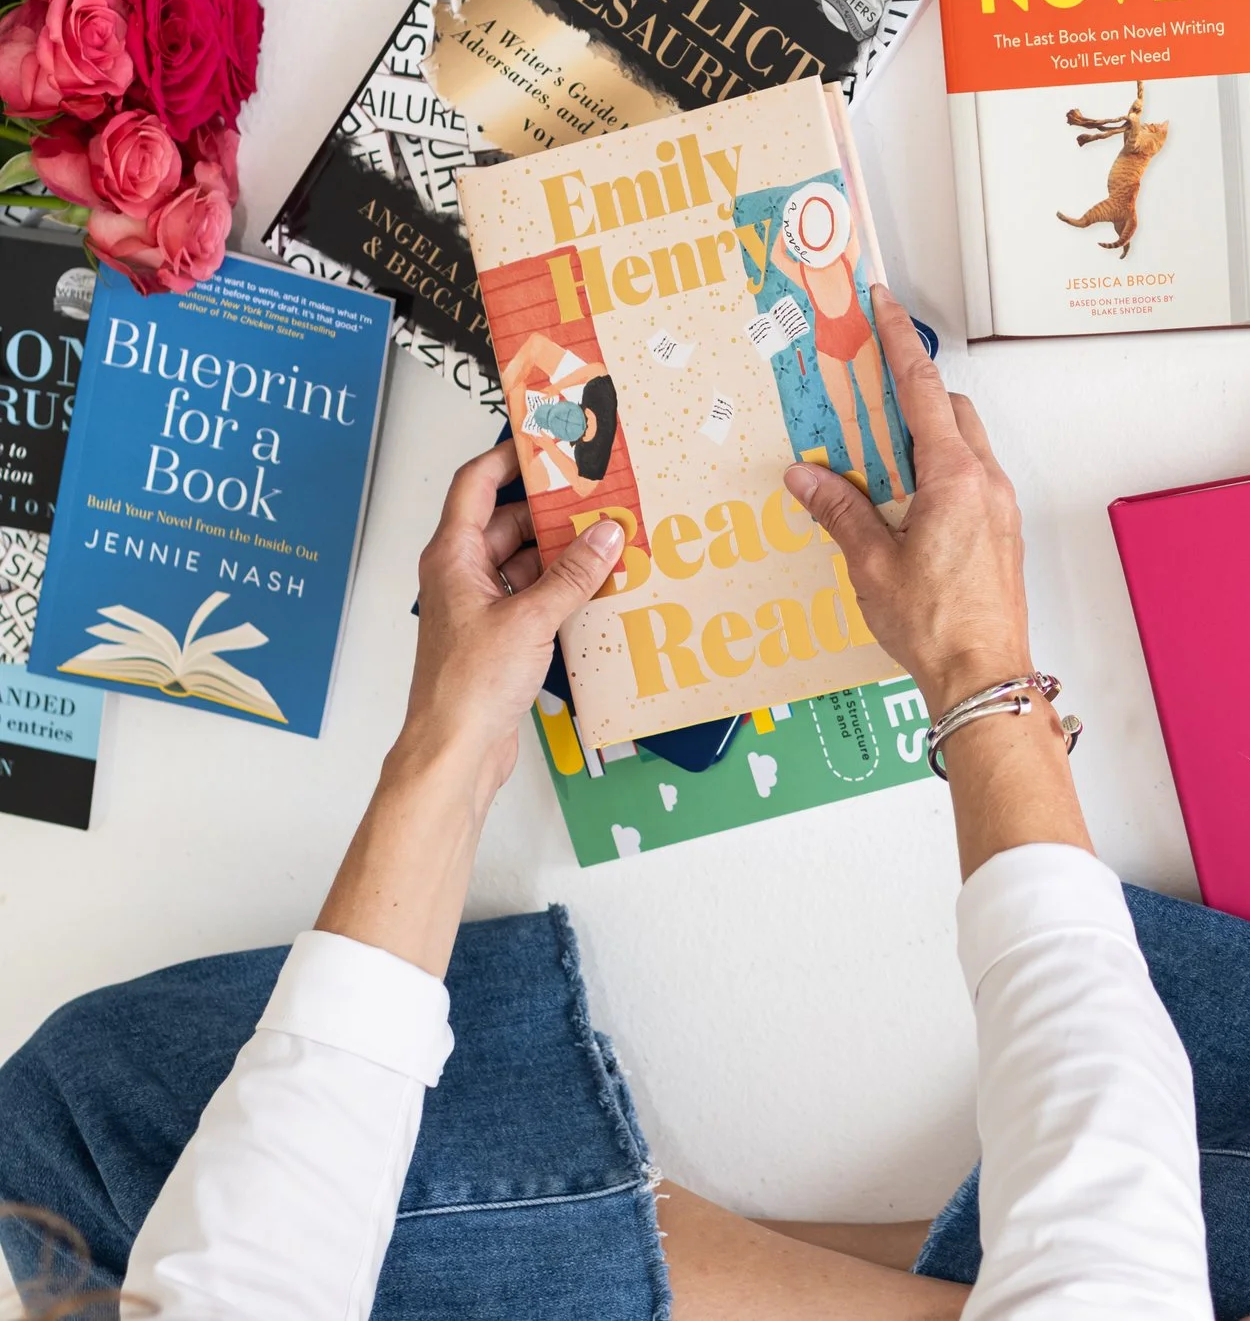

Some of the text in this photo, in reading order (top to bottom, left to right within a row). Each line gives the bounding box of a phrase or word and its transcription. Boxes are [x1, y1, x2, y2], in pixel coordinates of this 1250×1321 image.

[993, 19, 1225, 49] The Last Book on Novel Writing
[1050, 47, 1171, 70] You'll Ever Need
[450, 29, 595, 136] Adversaries, and
[476, 19, 618, 127] A Writer's Guide
[538, 134, 743, 245] Emily
[358, 198, 458, 284] ANGELA
[545, 212, 772, 326] Henry
[782, 201, 812, 265] a novel
[362, 236, 462, 322] & BECCA
[1065, 272, 1176, 290] JESSICA BRODY
[1091, 305, 1153, 316] BLAKE SNYDER
[103, 317, 357, 425] Blueprint
[161, 387, 280, 465] for a
[143, 444, 281, 521] Book
[84, 529, 305, 598] JENNIE NASH
[87, 494, 319, 562] Build Your Novel from the Inside Out
[616, 554, 878, 701] Read
[7, 717, 73, 744] entries
